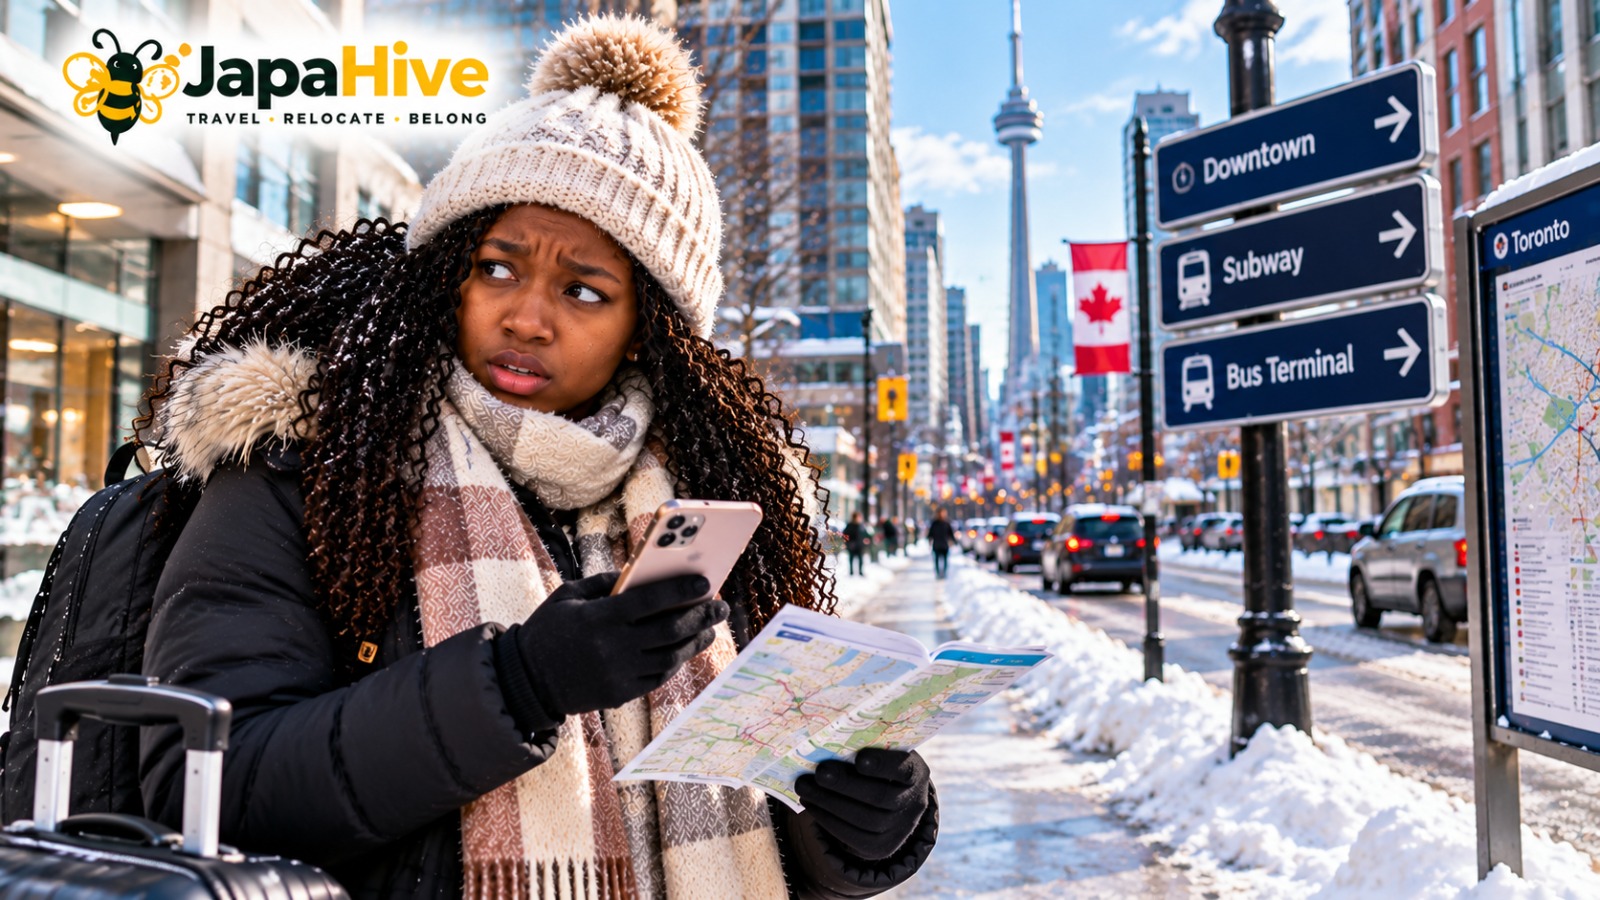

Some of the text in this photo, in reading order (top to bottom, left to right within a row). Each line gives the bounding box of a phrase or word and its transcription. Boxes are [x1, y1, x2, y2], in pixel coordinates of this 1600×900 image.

[1203, 134, 1315, 184] Downtown
[1512, 219, 1569, 253] Toronto
[1222, 247, 1304, 285] Subway
[1226, 343, 1354, 390] Bus Terminal
